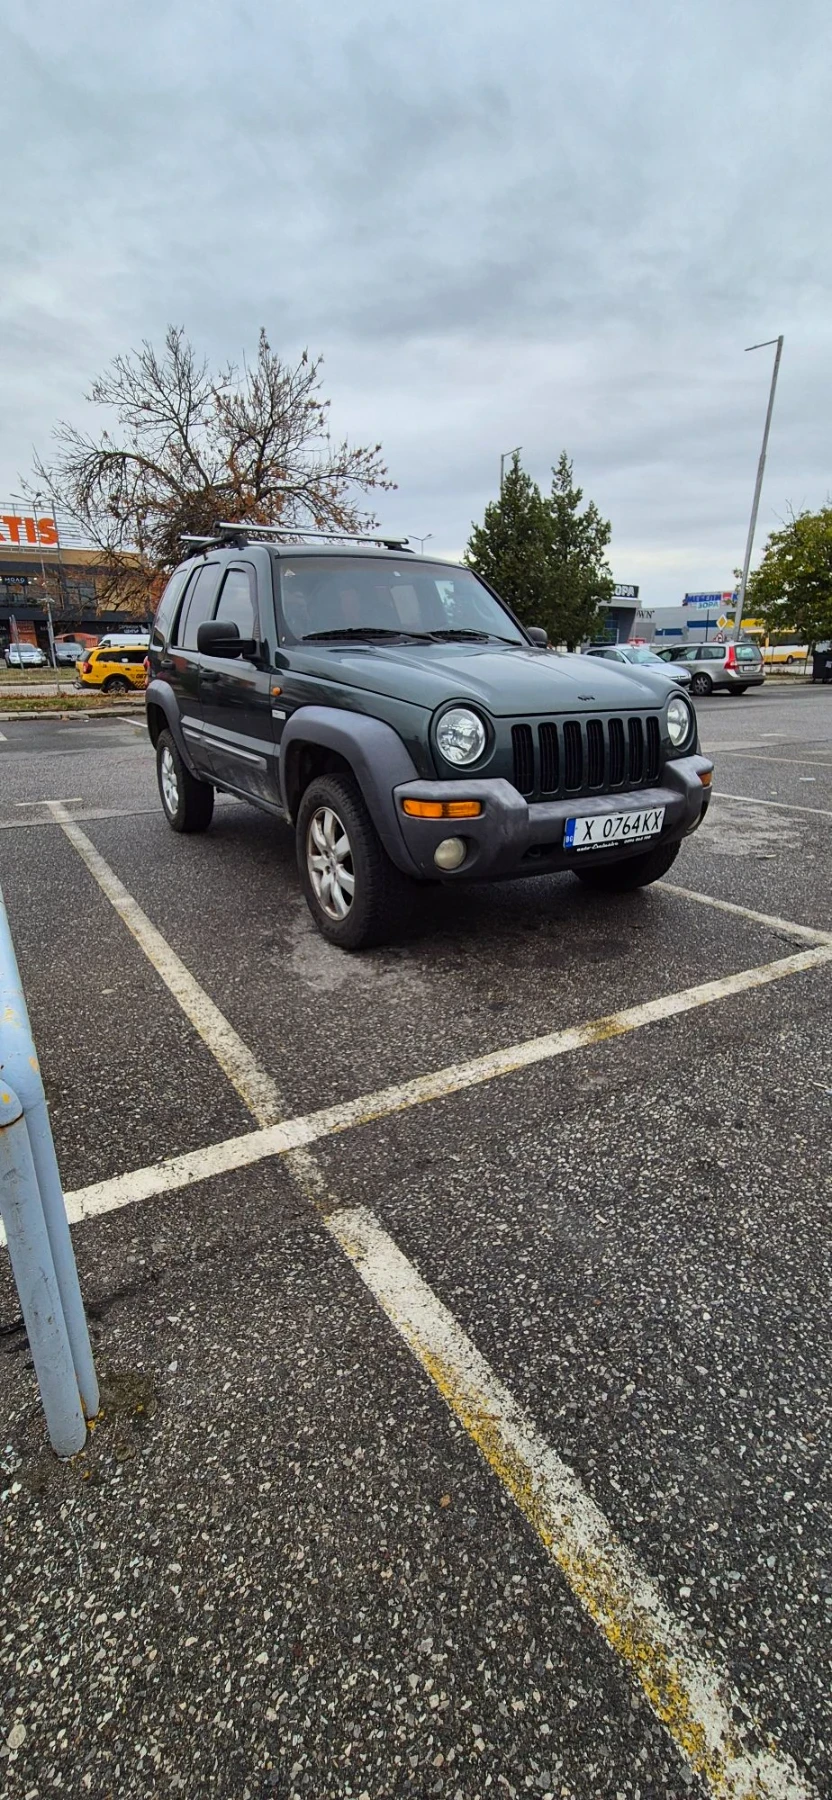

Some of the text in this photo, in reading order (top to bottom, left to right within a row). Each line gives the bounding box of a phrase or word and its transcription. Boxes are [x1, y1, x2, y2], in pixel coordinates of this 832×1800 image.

[613, 585, 635, 597] ОРА
[636, 610, 654, 619] WN
[582, 811, 661, 841] X 0764KX
